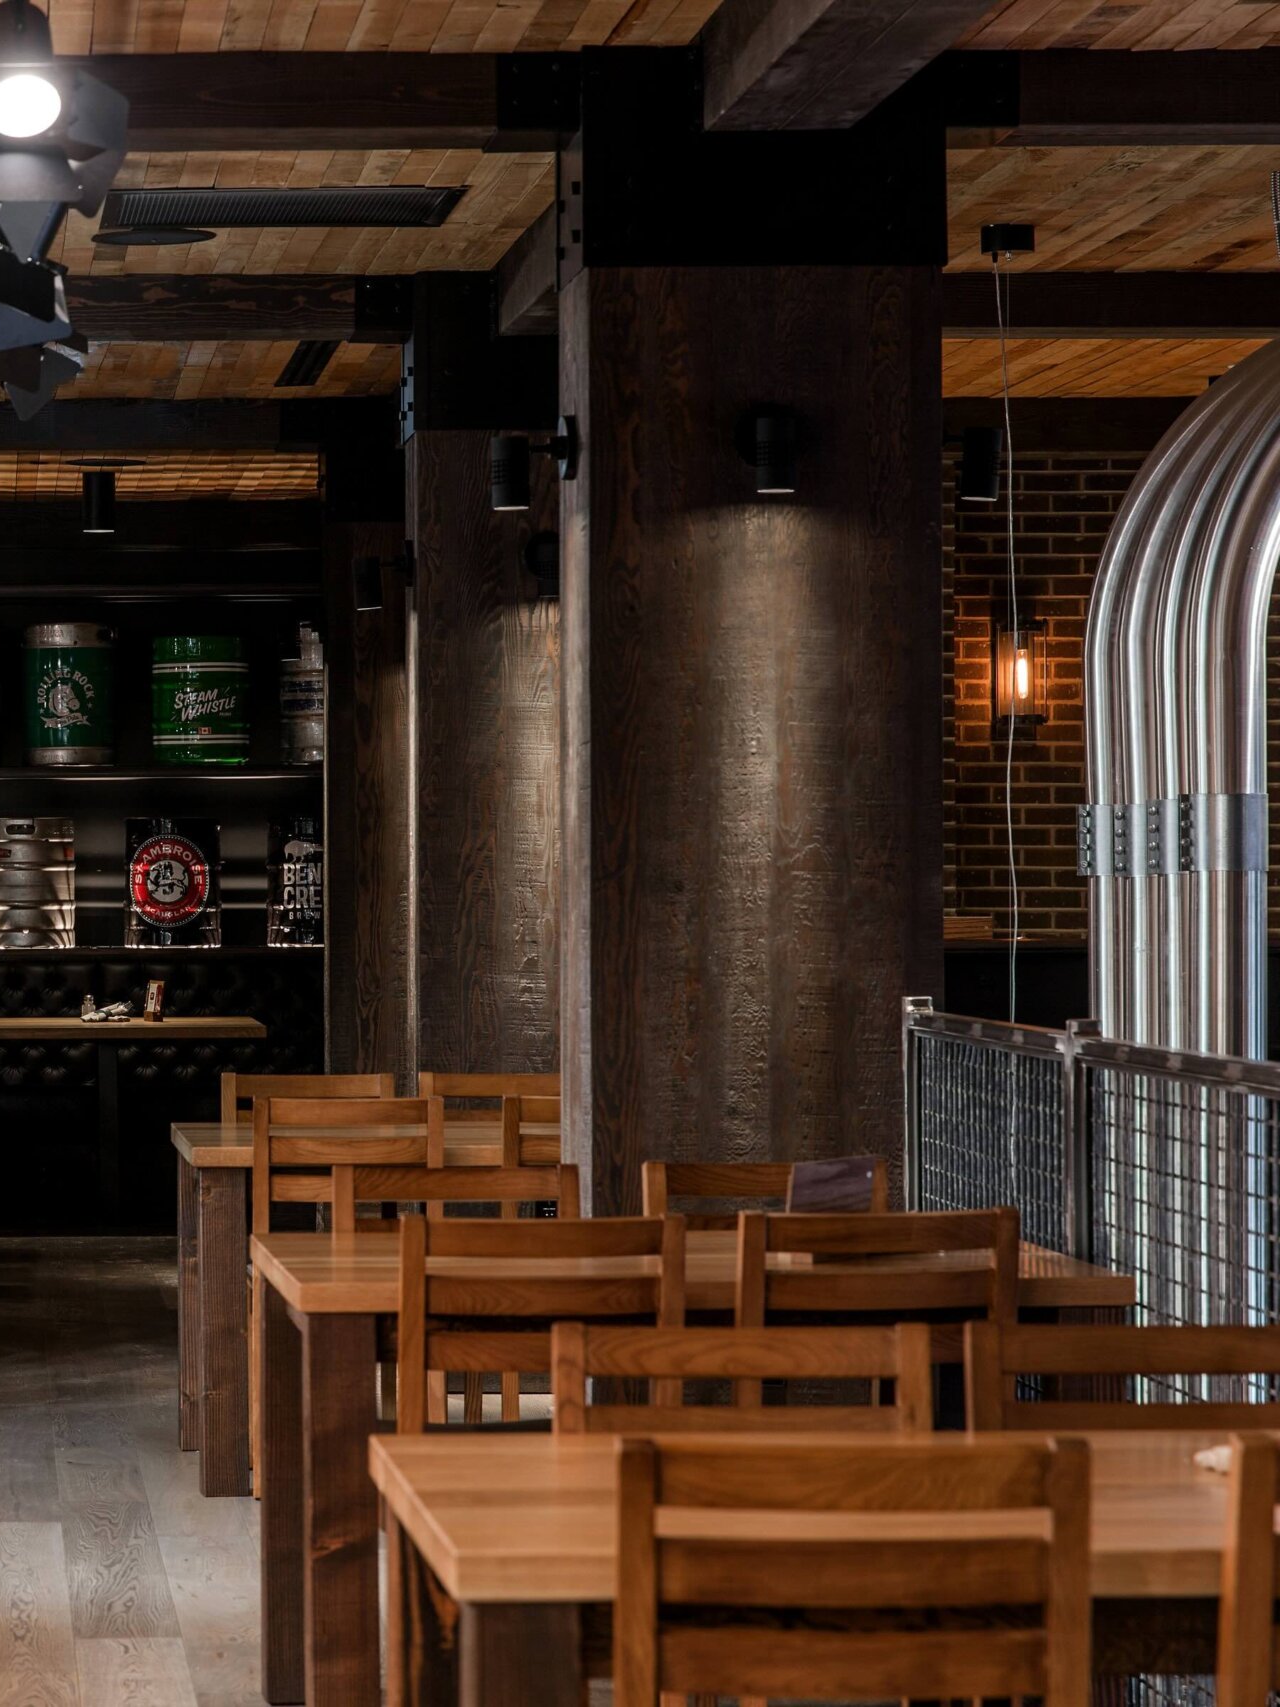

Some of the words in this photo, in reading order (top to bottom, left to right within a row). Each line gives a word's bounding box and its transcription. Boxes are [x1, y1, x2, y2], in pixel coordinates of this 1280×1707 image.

[37, 668, 72, 704] ROLLING
[71, 671, 96, 699] ROCK
[174, 688, 219, 709] STEAM
[181, 696, 237, 721] WHISTLE
[283, 863, 322, 885] BEN
[283, 886, 323, 908] CRE
